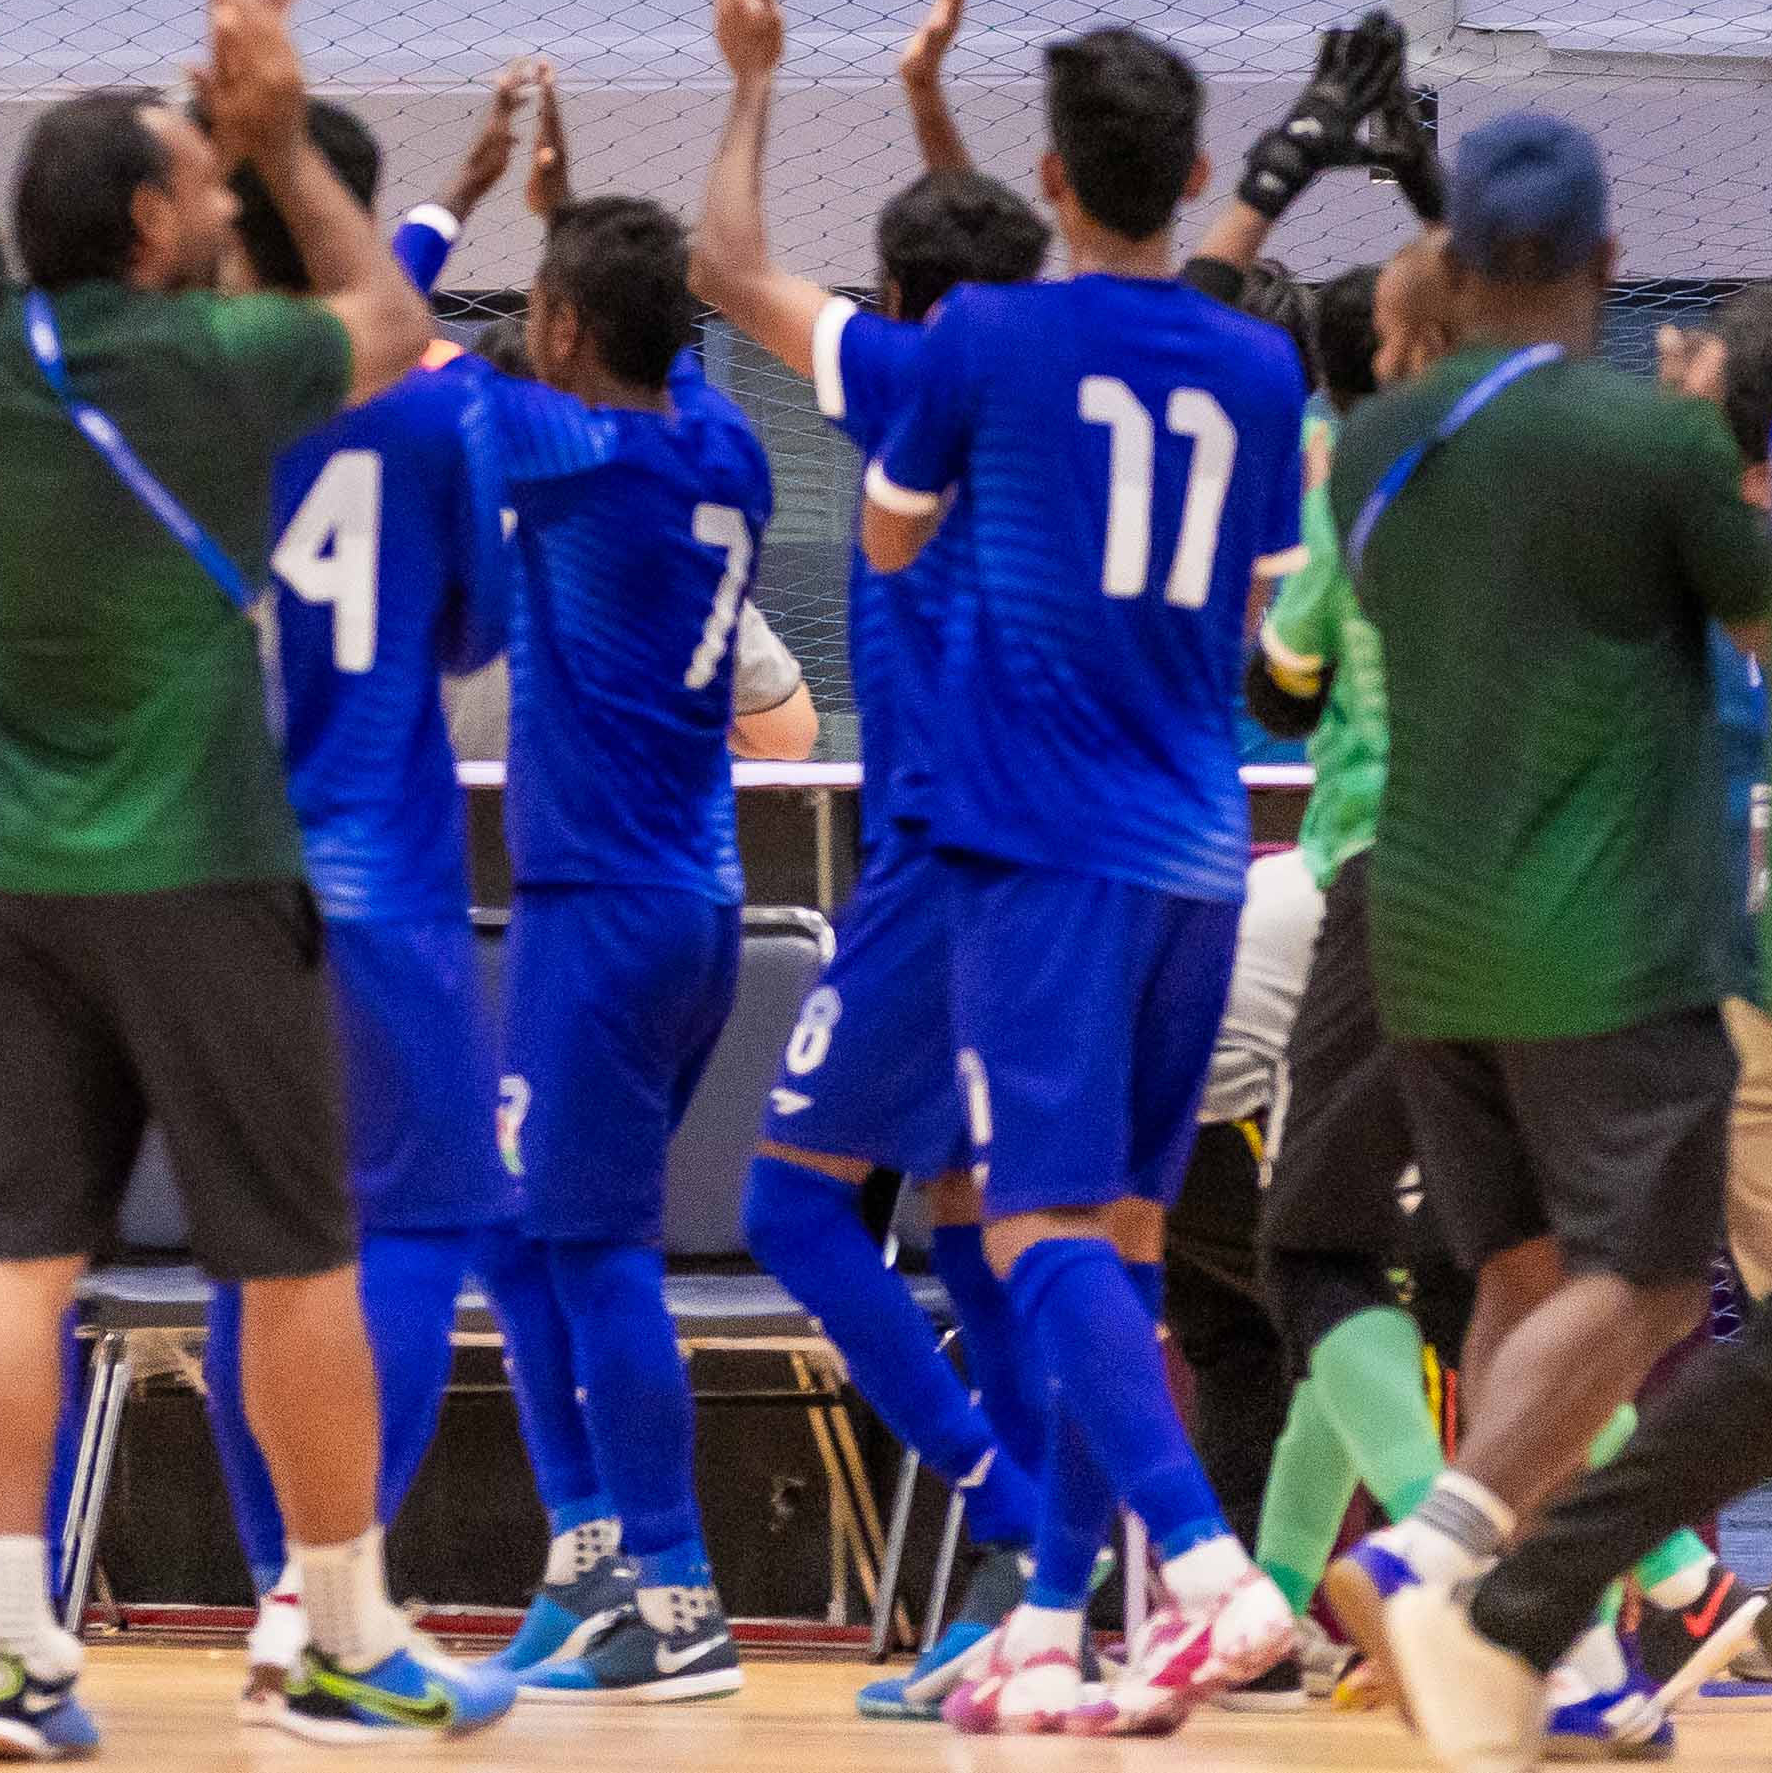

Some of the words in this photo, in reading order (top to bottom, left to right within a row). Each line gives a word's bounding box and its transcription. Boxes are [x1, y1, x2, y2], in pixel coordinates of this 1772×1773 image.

[270, 448, 383, 674] 4
[1077, 374, 1237, 610] 11
[683, 503, 754, 691] 7
[784, 985, 843, 1076] 8
